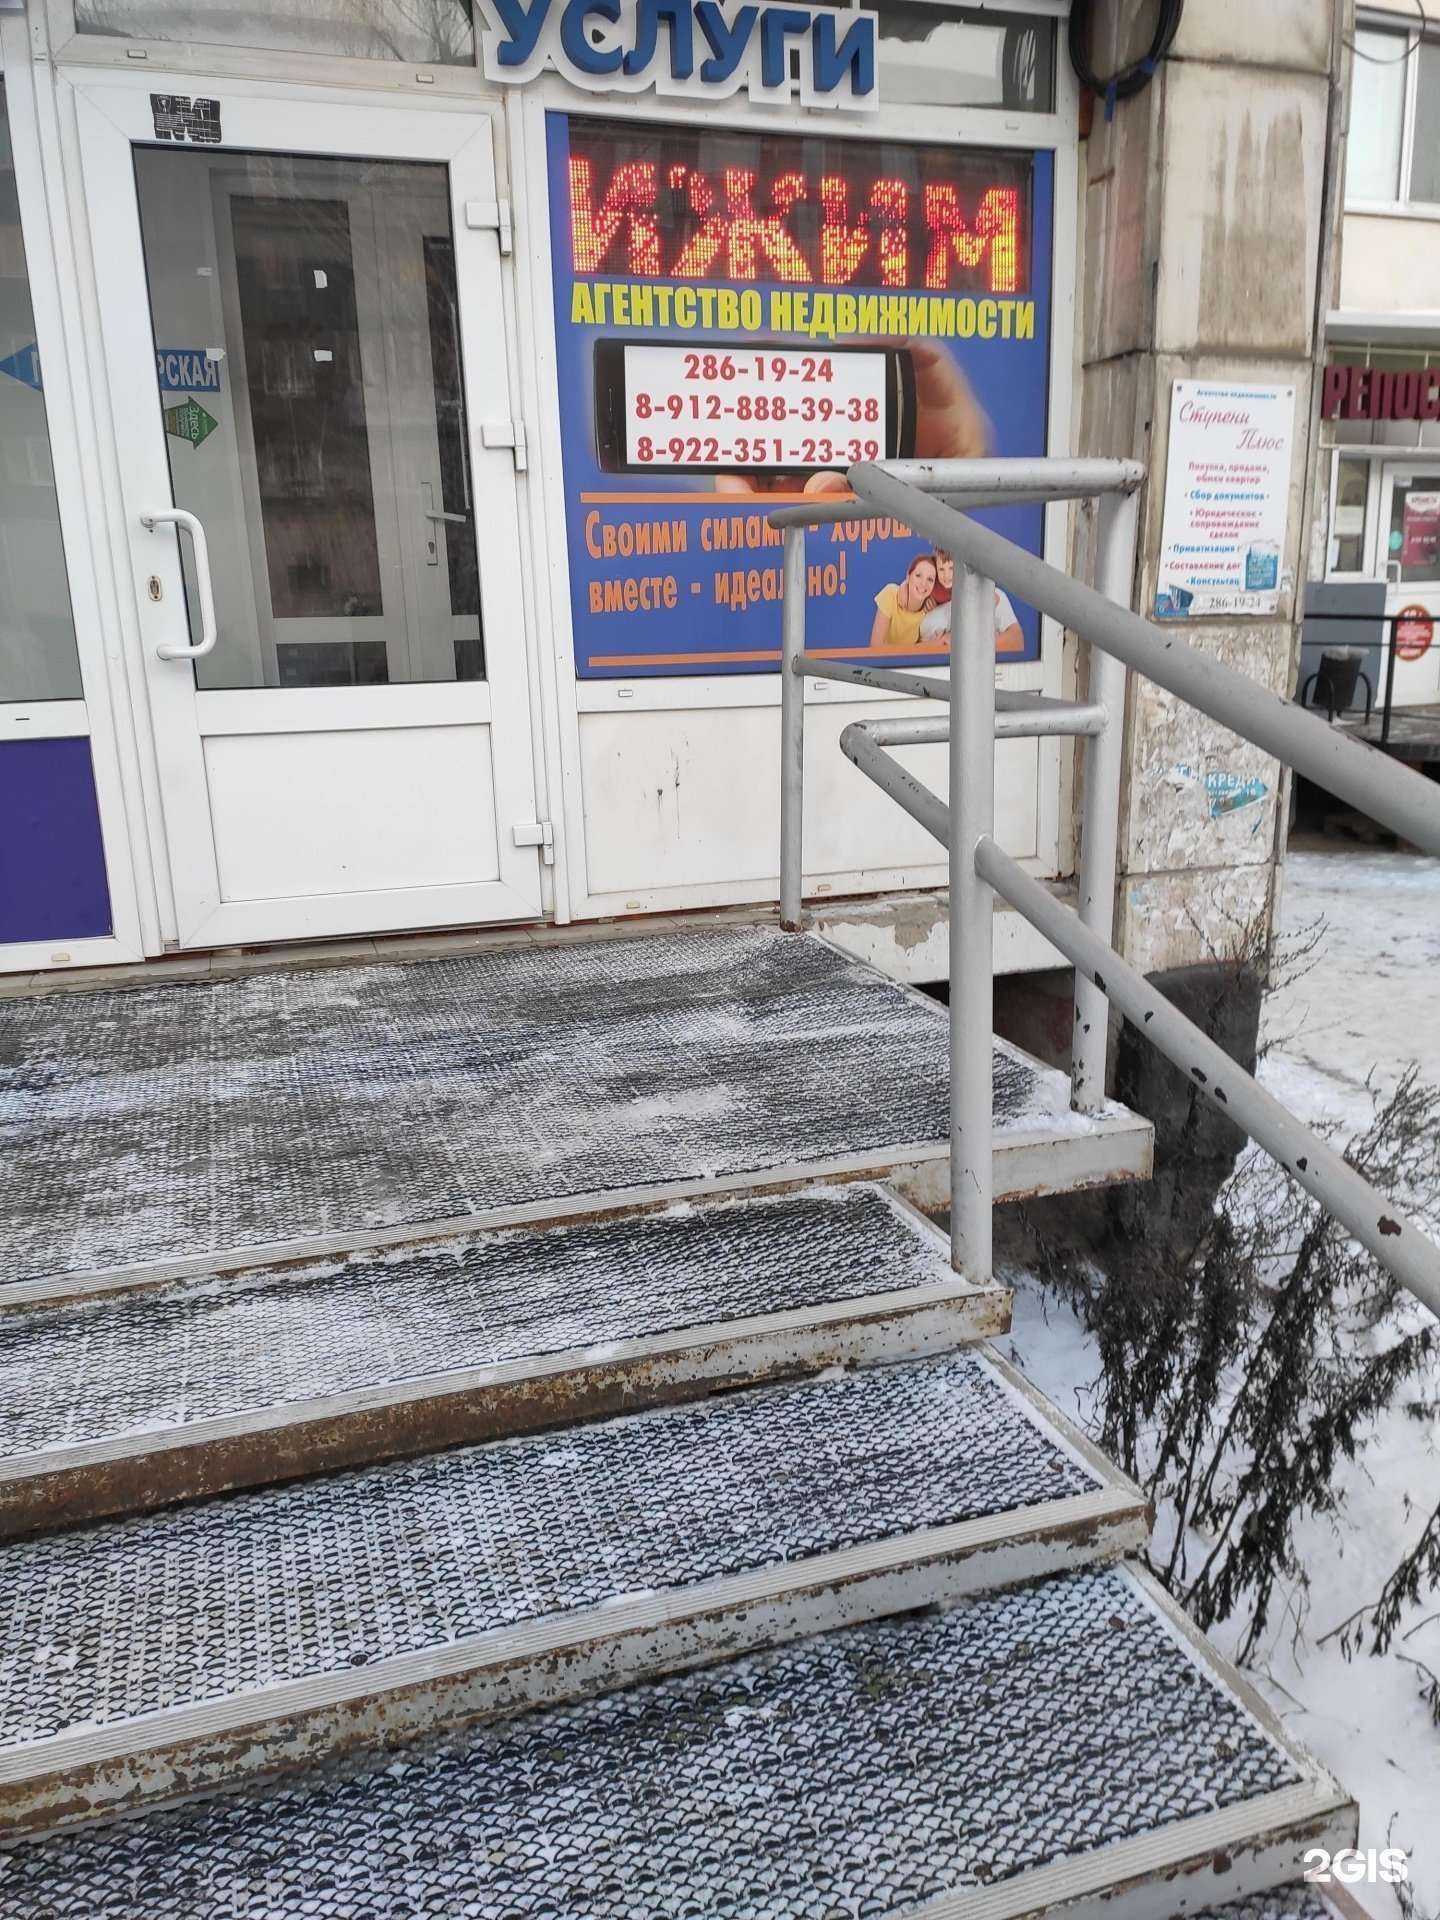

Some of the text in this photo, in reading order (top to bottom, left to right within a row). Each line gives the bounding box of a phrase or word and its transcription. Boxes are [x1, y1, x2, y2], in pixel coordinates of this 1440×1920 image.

[495, 0, 875, 96] УСЛУГИ
[571, 281, 1036, 341] АГЕНТСТВО НЕДВИЖИМОСТИ
[684, 353, 834, 383] 286-19-24
[635, 392, 880, 423] 8-912-888-39-38
[1179, 400, 1251, 430] Ступени
[636, 436, 880, 464] 8-922-351-23-39
[1235, 427, 1285, 451] Плюс
[1190, 488, 1265, 502] Сбор документов
[585, 509, 688, 559] Своими
[700, 514, 785, 552] силам
[588, 574, 679, 614] вместе
